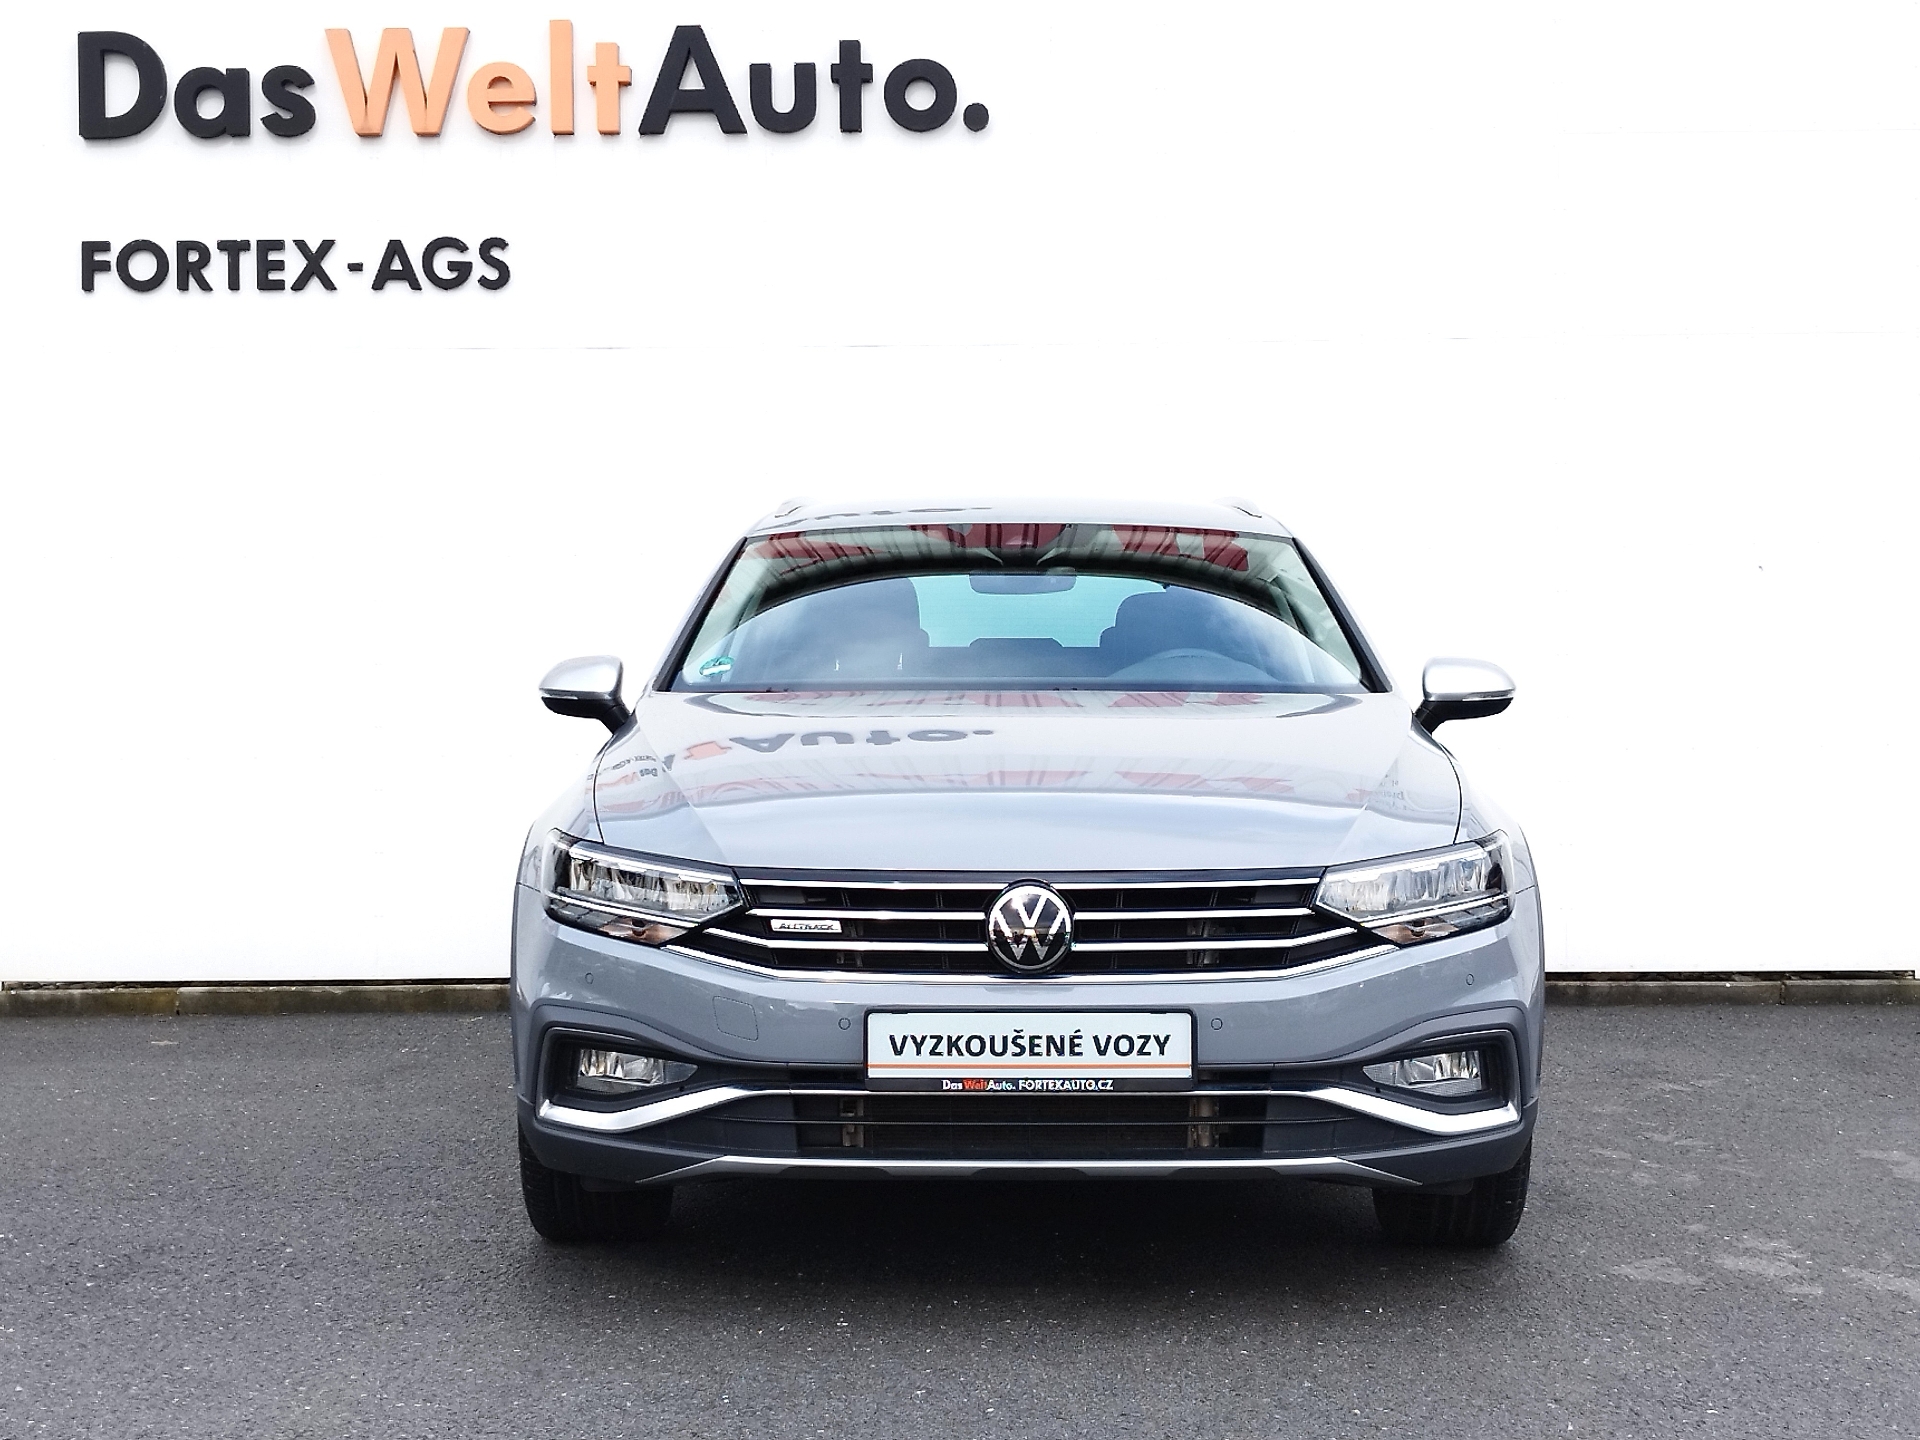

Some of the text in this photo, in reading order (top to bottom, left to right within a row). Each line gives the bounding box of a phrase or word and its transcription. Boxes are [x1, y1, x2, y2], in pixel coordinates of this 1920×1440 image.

[889, 1029, 1172, 1057] VYZKOUŠENÉ VOZY
[1018, 1079, 1114, 1091] FORTEXAUTO.CZ
